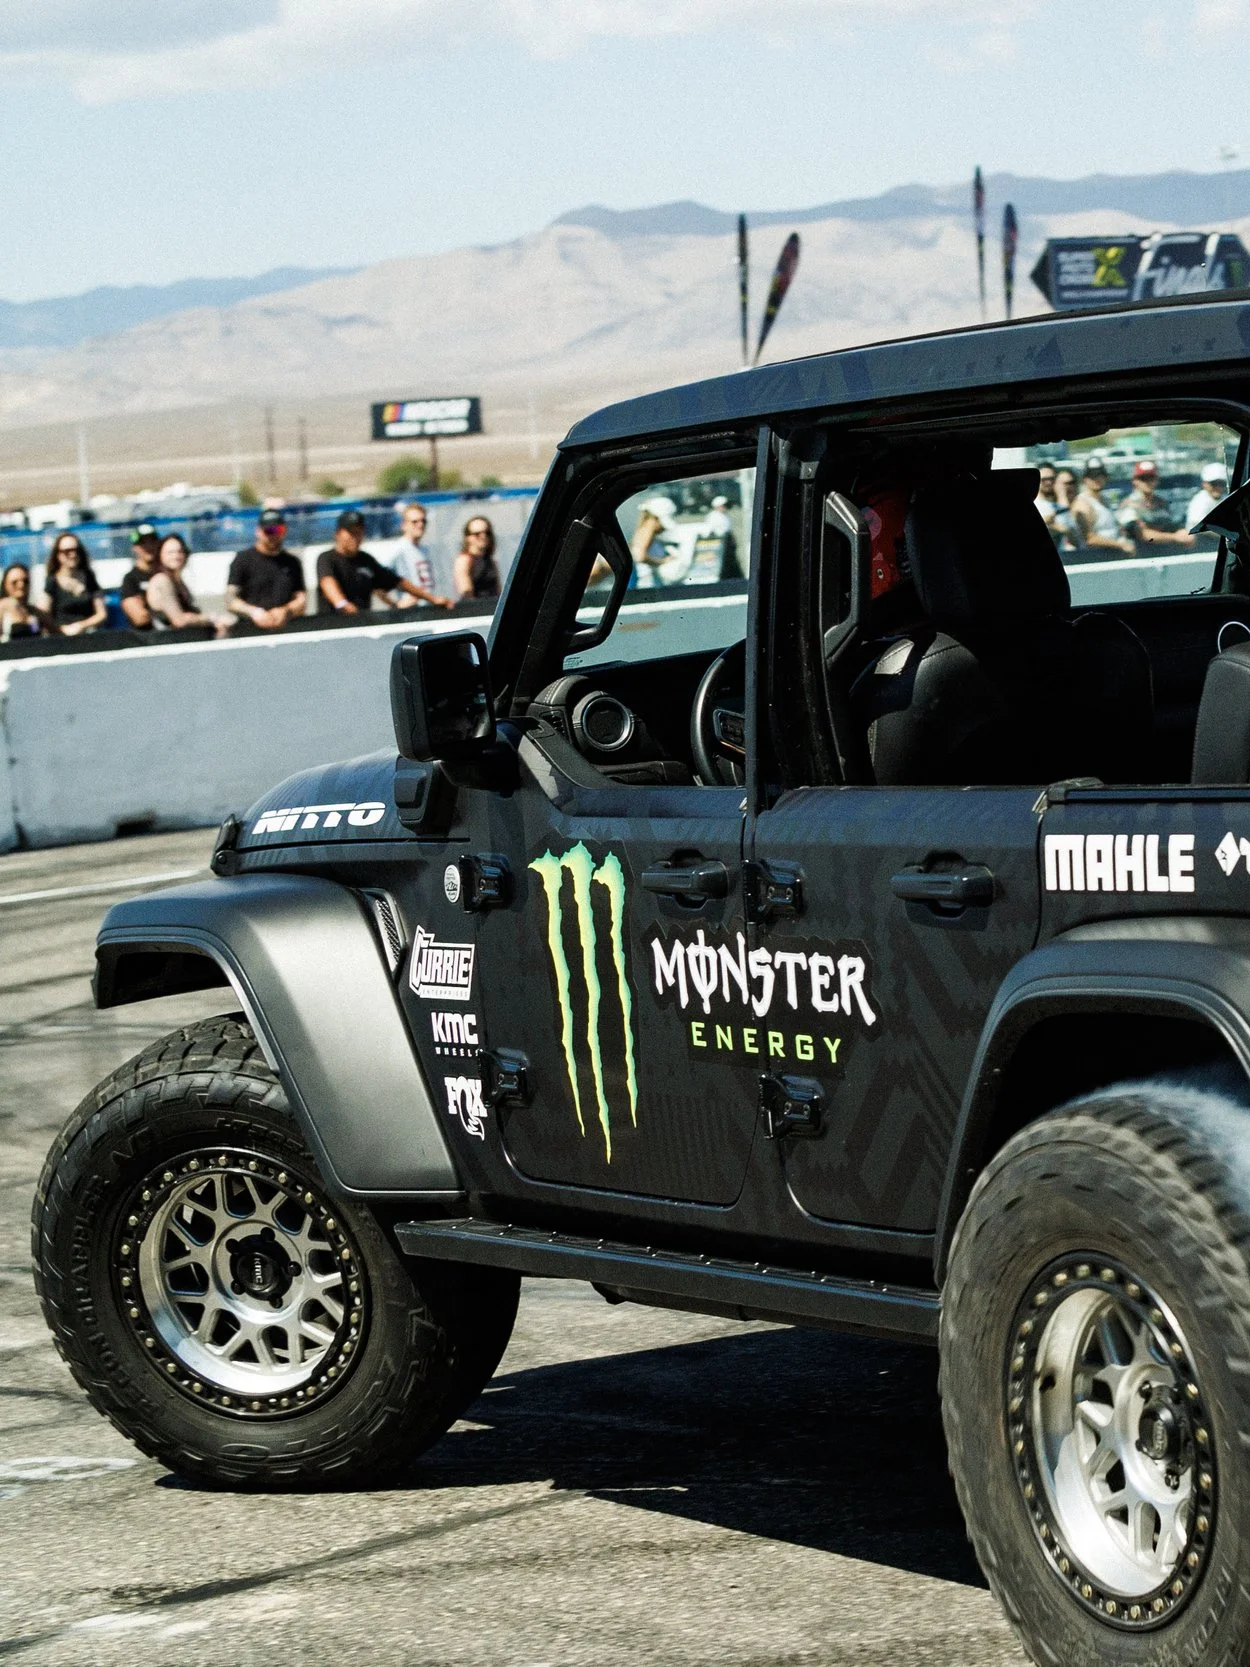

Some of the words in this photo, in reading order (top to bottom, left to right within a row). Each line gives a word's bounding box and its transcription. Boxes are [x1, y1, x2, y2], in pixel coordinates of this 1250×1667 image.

[252, 802, 386, 835] NITTO
[1045, 834, 1195, 892] MAHLE
[411, 931, 472, 988] CURRIE
[651, 929, 877, 1026] MONSTER
[431, 1011, 479, 1045] KMC
[691, 1021, 842, 1063] ENERGY
[444, 1075, 489, 1132] FOX
